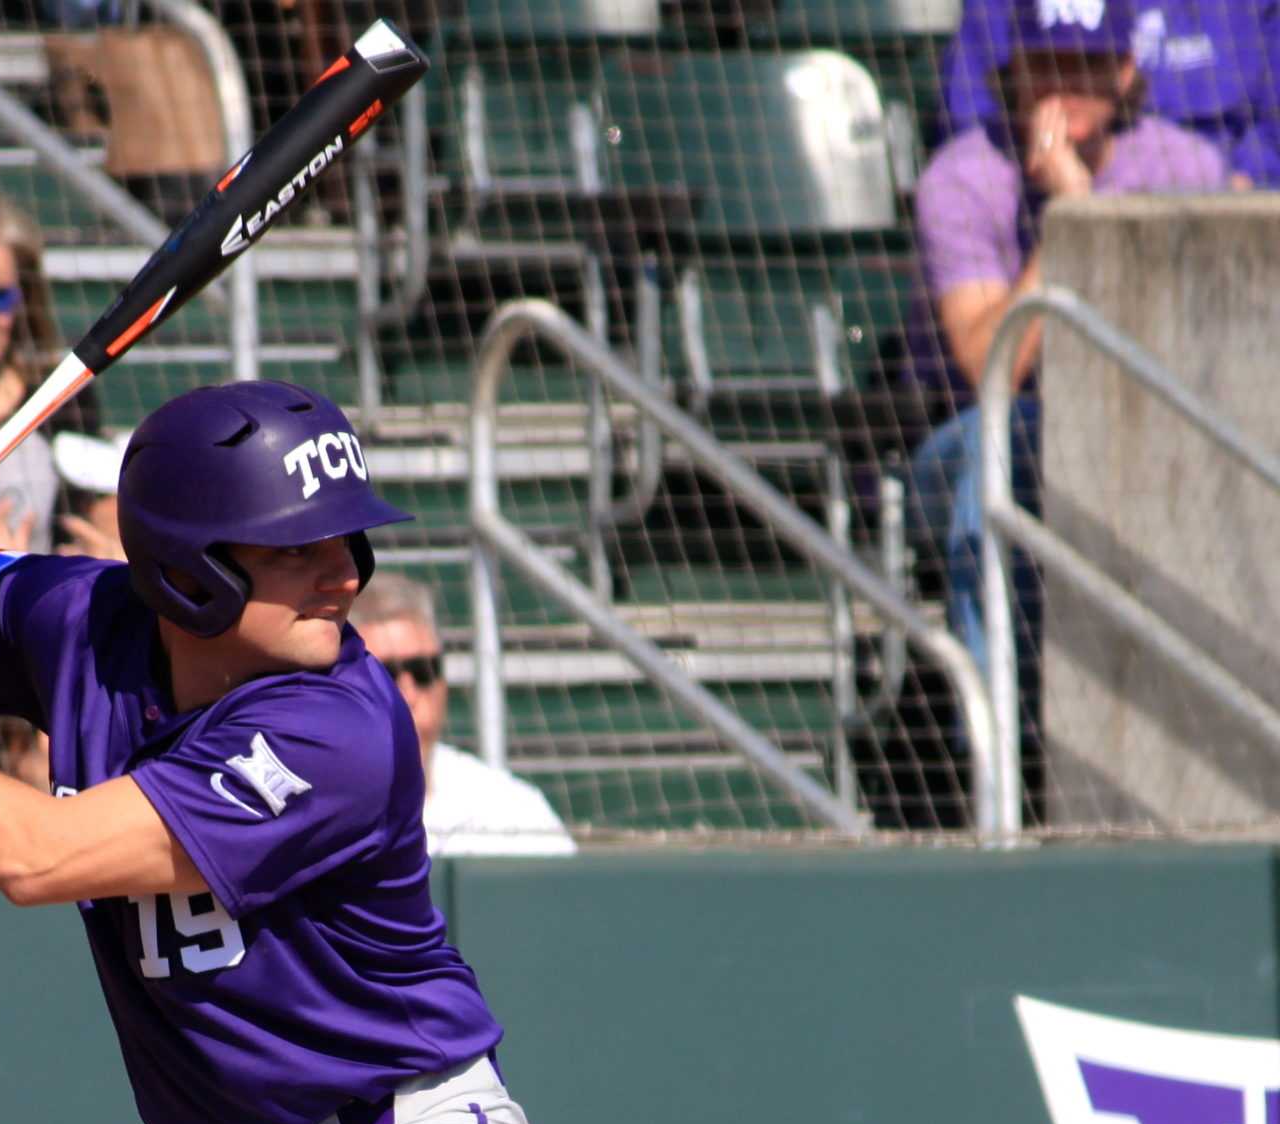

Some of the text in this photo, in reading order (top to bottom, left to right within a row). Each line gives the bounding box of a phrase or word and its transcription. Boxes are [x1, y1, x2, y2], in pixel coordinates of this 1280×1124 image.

[246, 135, 343, 237] EASTON
[283, 431, 367, 500] TCU
[128, 891, 246, 978] 19
